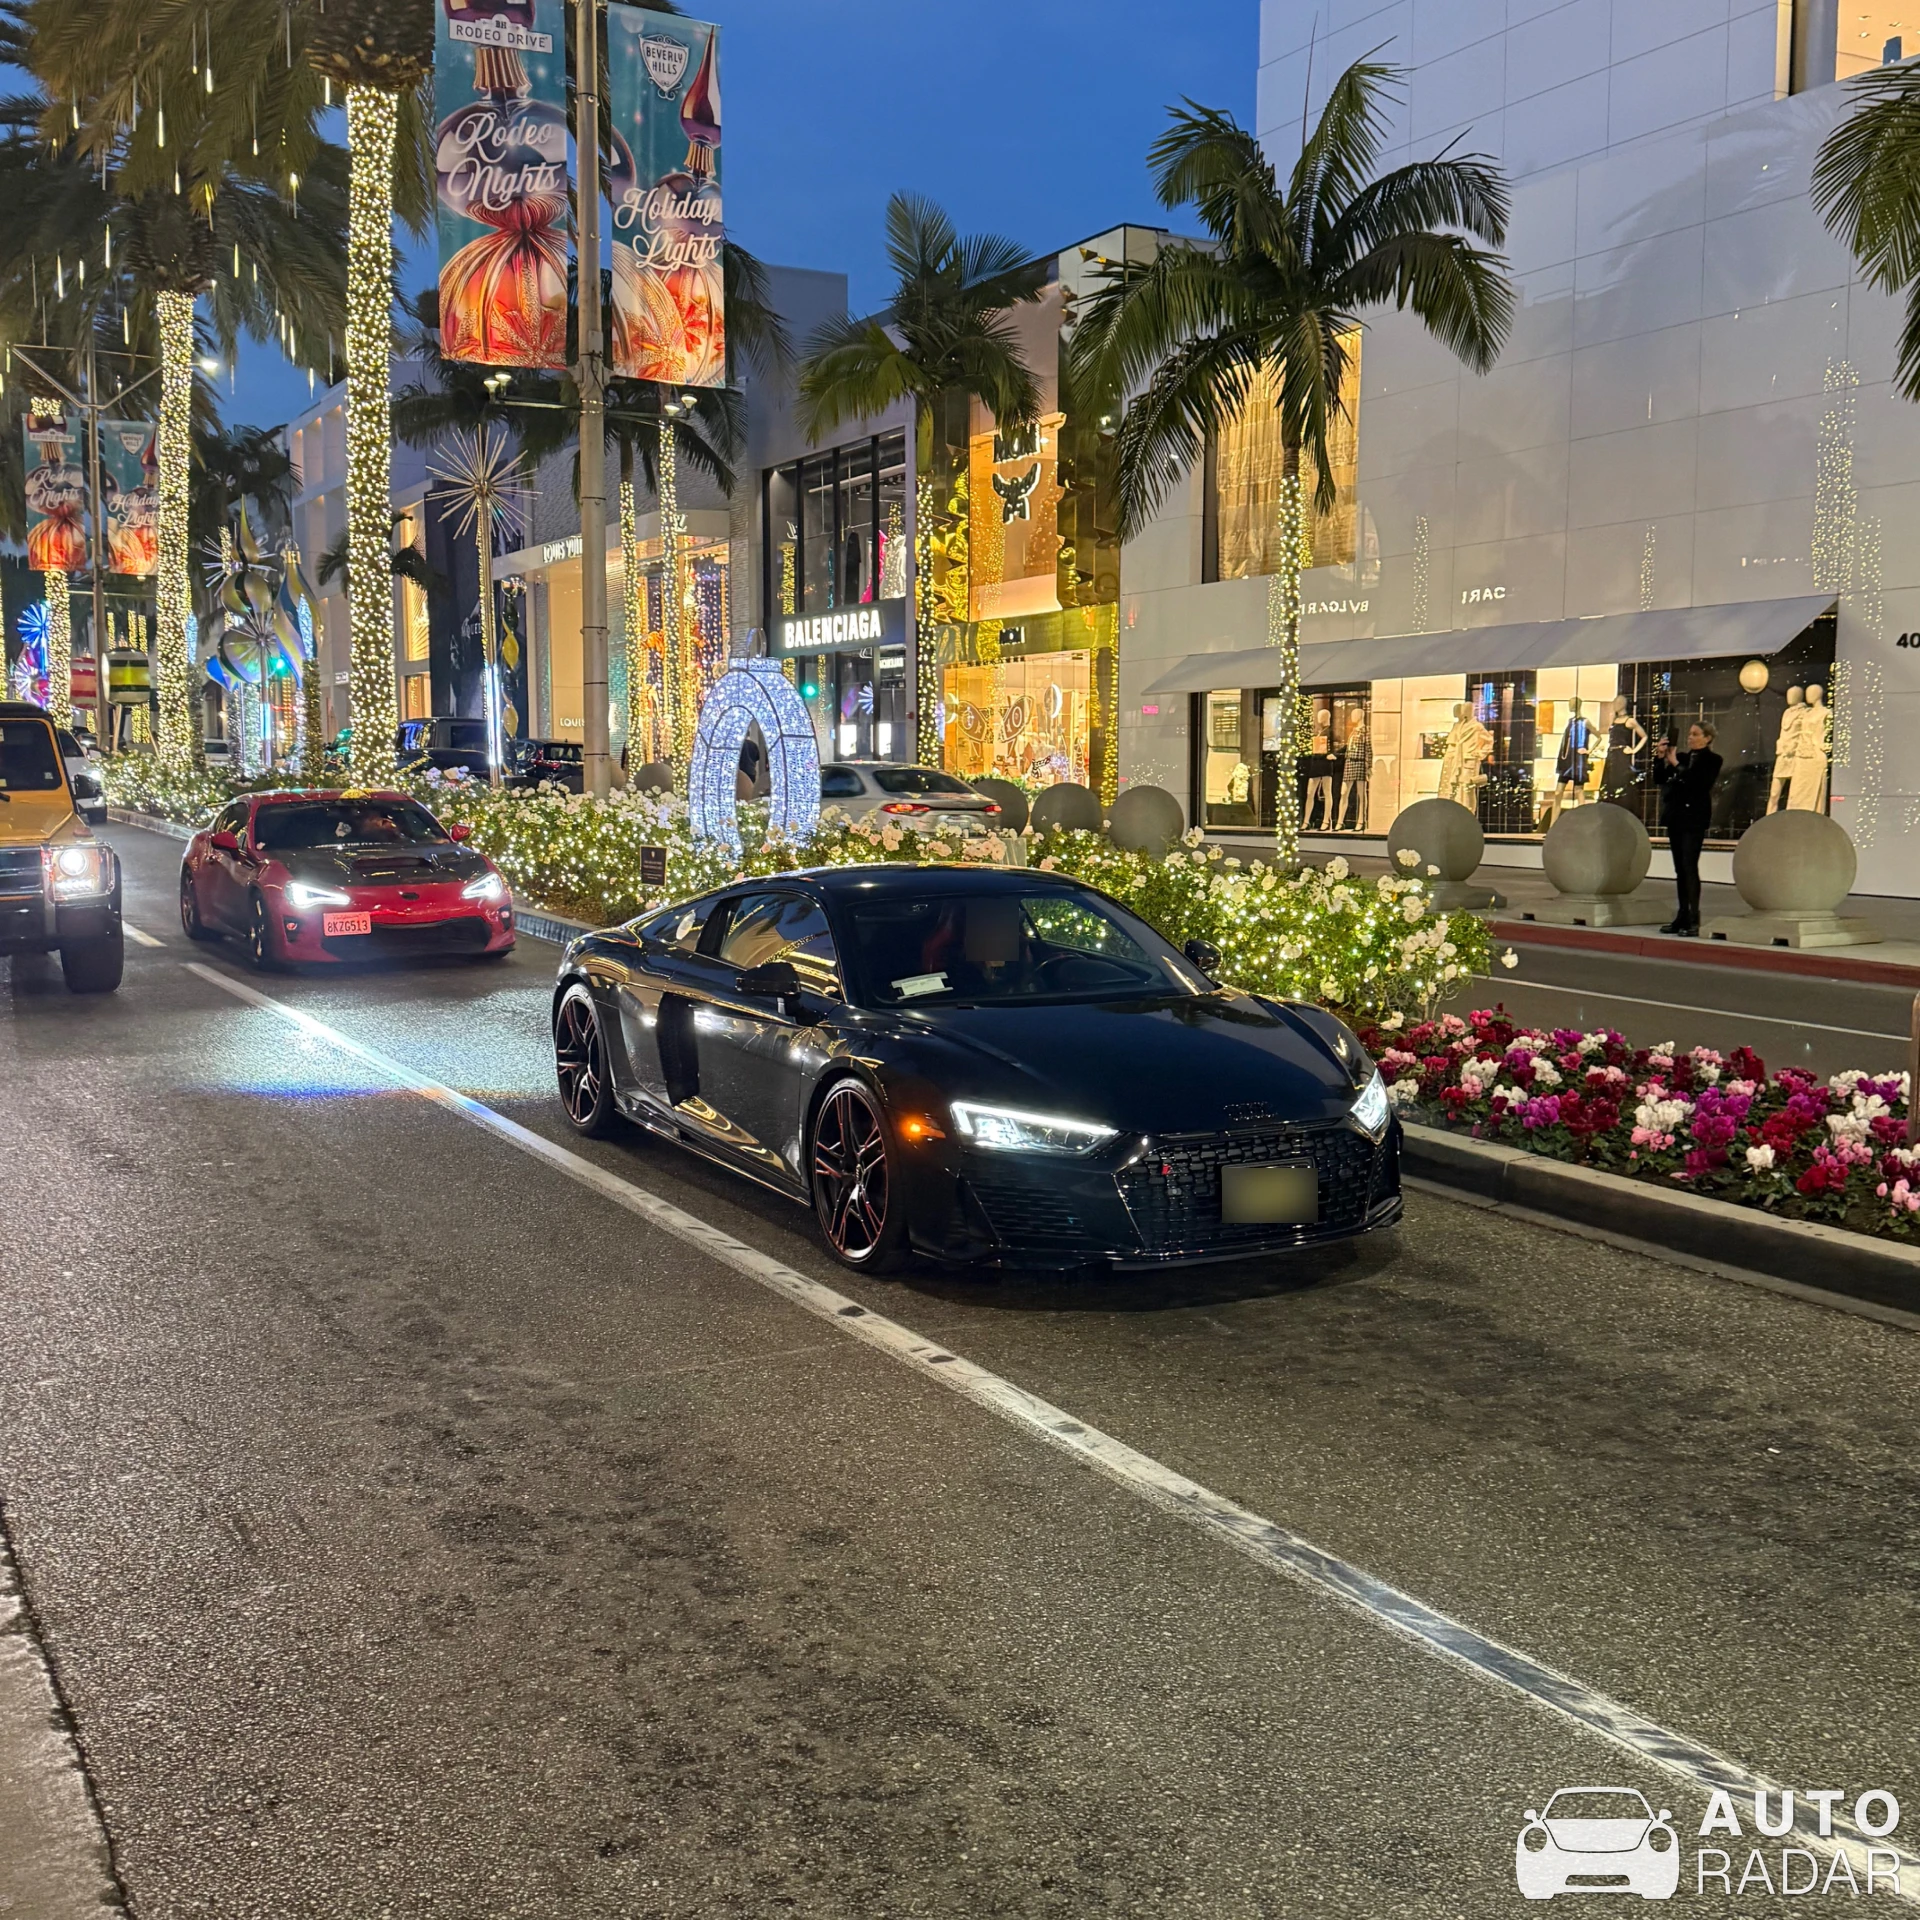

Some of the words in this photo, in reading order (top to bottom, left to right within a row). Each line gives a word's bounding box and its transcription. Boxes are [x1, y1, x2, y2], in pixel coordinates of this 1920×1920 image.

[456, 24, 501, 41] RODEO
[507, 32, 546, 48] DRIVE
[646, 46, 683, 63] BEVERLY
[652, 61, 677, 75] HILLS
[453, 112, 552, 163] Rodeo
[447, 158, 562, 211] Nights
[614, 187, 719, 234] Holiday
[632, 229, 721, 271] Lights
[33, 469, 77, 490] Rode
[30, 487, 80, 509] Nights
[543, 541, 566, 563] LOUIS
[784, 609, 881, 648] BALENCIAGA
[327, 920, 368, 933] 8KZG513
